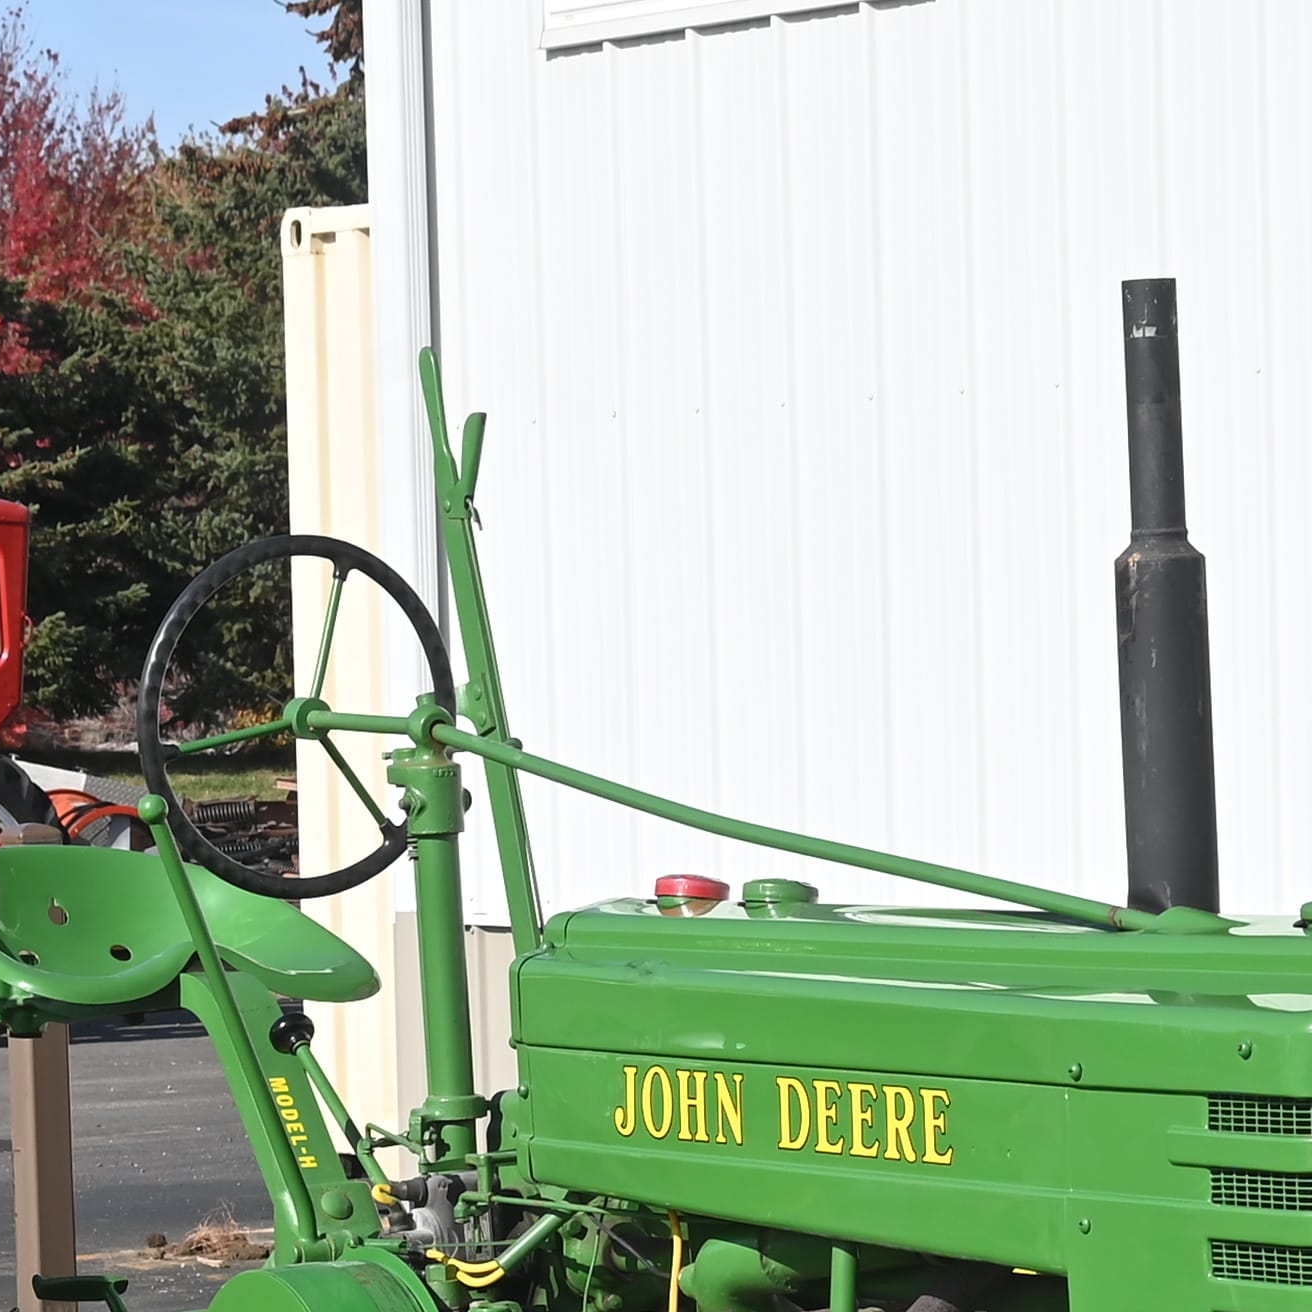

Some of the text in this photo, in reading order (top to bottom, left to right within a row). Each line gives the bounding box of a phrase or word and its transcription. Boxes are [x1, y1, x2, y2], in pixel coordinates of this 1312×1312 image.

[268, 1077, 319, 1169] MODEL-H
[614, 1064, 954, 1165] JOHN DEERE
